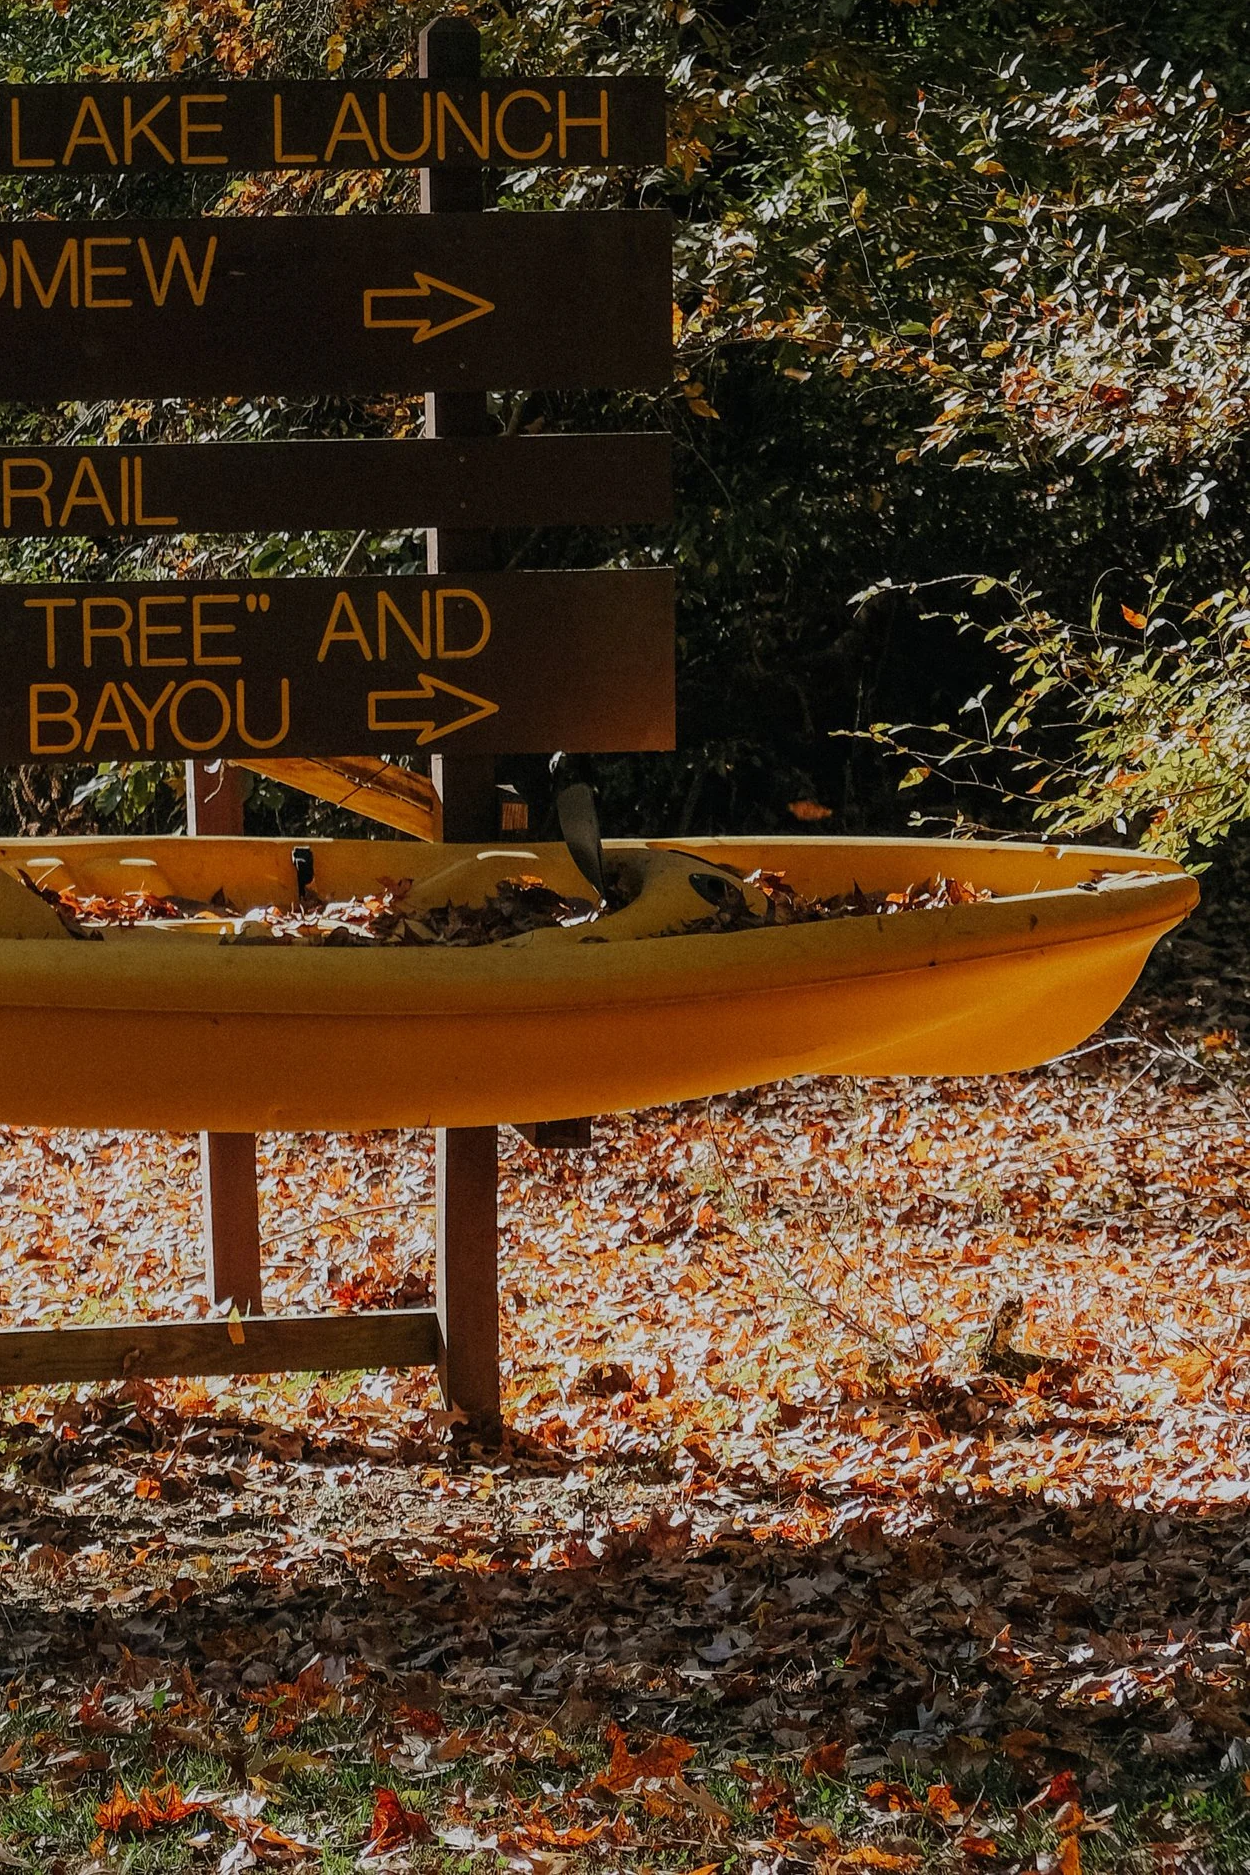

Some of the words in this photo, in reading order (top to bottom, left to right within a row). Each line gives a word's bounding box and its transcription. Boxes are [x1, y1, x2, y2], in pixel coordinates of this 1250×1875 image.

[11, 94, 229, 168] LAKE
[273, 88, 609, 163] LAUNCH
[23, 593, 271, 669] TREE"
[317, 588, 493, 663] AND
[29, 677, 291, 755] BAYOU
